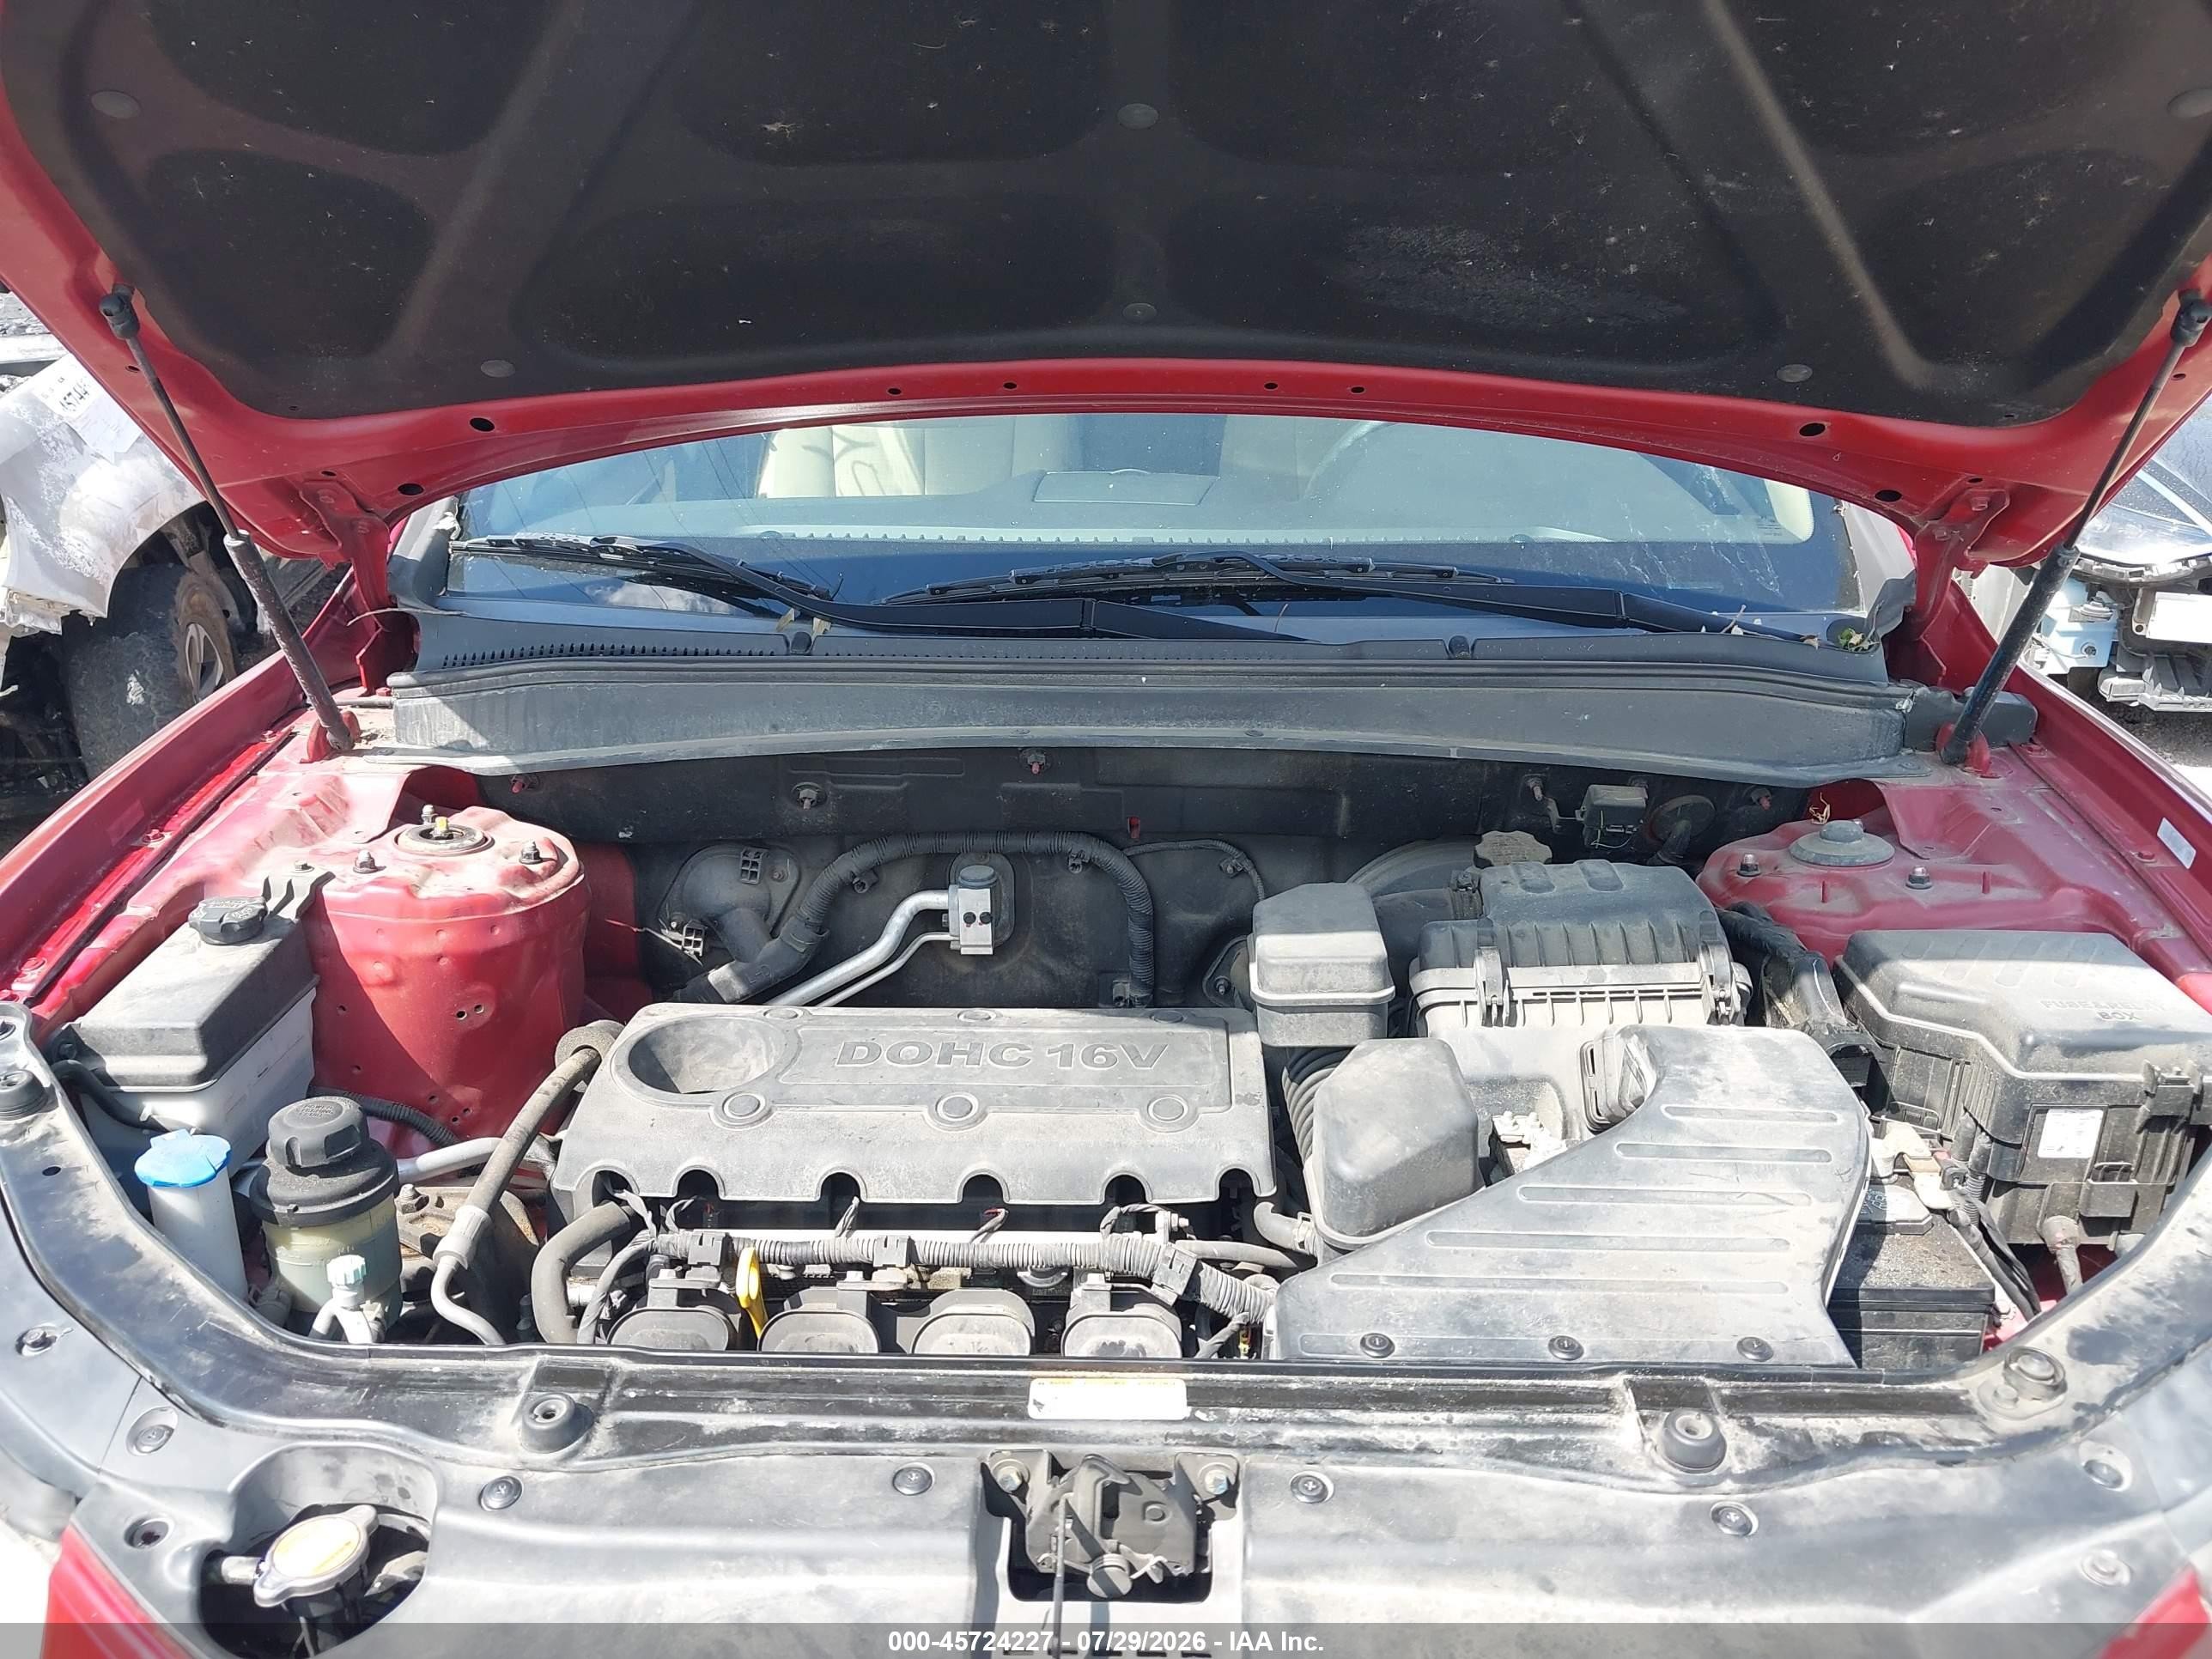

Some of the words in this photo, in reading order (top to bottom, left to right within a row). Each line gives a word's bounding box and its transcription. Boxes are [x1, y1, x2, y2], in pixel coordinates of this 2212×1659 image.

[2097, 1011, 2143, 1021] BOX
[835, 1040, 1032, 1068] DOHC
[1047, 1042, 1169, 1070] 16V
